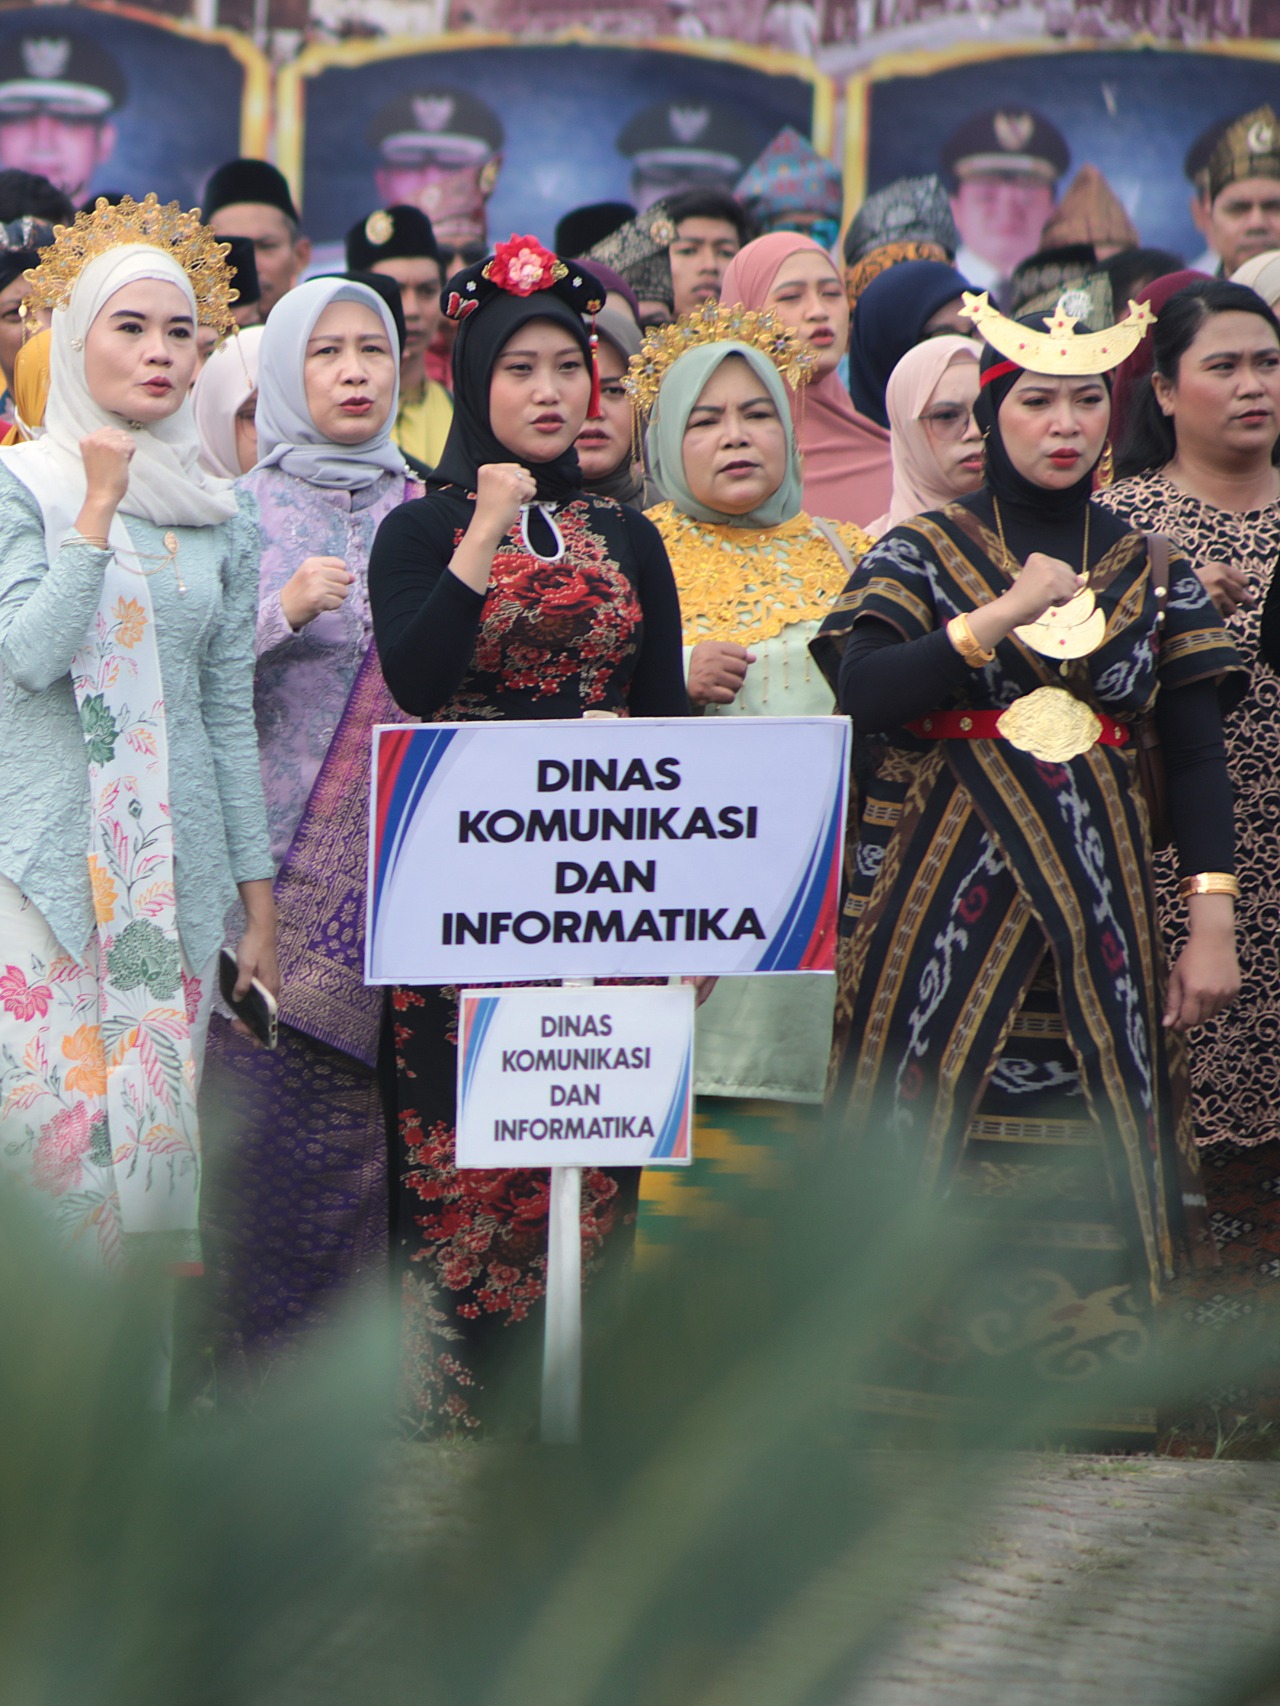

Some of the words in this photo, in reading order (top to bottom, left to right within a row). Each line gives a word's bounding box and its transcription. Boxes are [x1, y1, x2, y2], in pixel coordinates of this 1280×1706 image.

[537, 757, 681, 792] DINAS
[458, 806, 758, 843] KOMUNIKASI
[555, 860, 656, 894] DAN
[441, 907, 766, 945] INFORMATIKA
[540, 1014, 613, 1038] DINAS
[502, 1047, 651, 1073] KOMUNIKASI
[550, 1083, 601, 1107] DAN
[494, 1116, 655, 1142] INFORMATIKA
